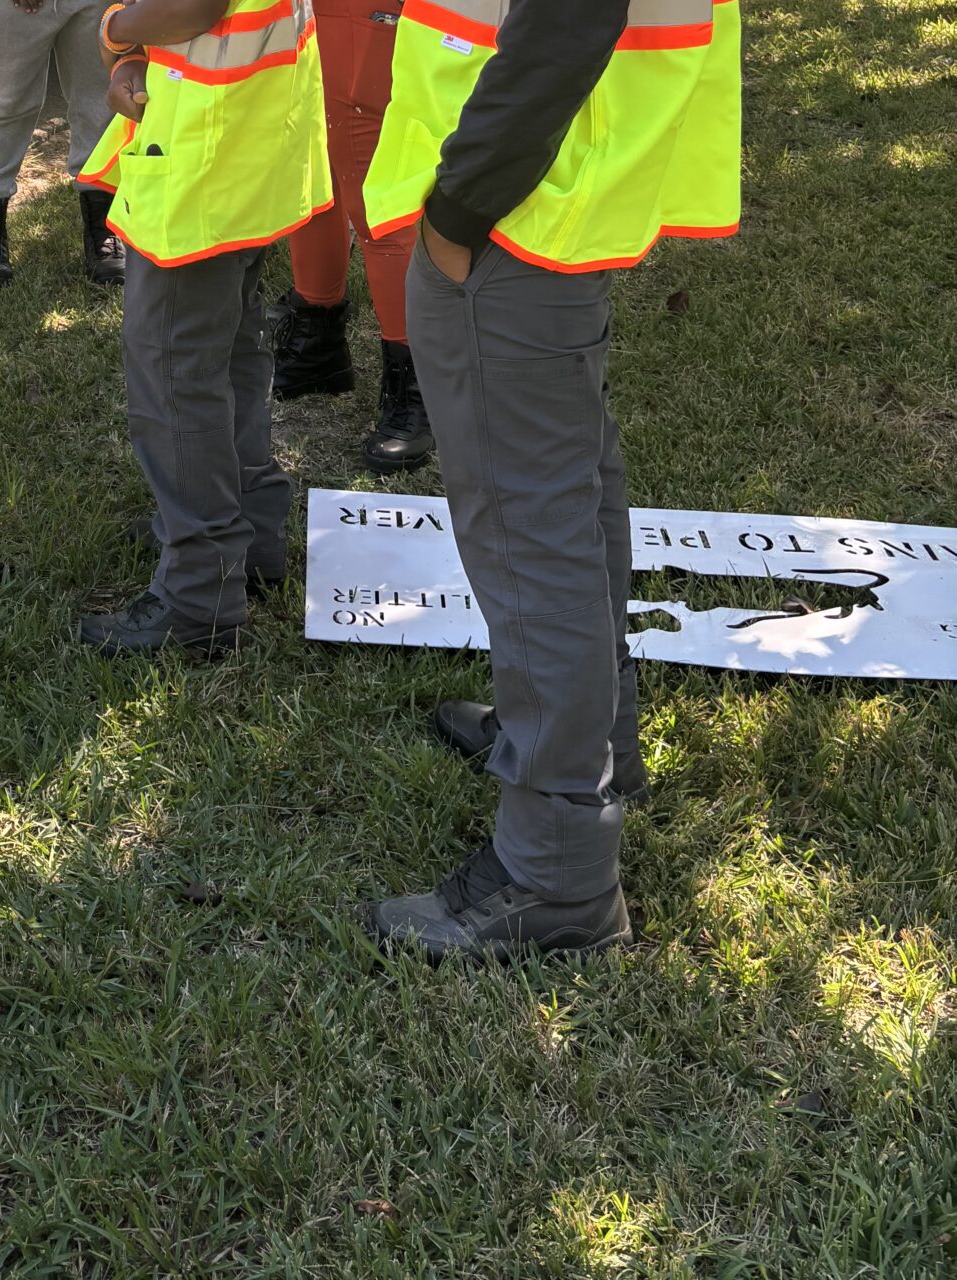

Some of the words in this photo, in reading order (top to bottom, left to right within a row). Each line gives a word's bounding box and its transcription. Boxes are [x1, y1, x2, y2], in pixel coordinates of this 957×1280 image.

[339, 506, 444, 531] VER
[632, 526, 711, 551] PE
[738, 532, 816, 554] TO
[332, 588, 471, 609] LITTER
[332, 609, 385, 627] NO
